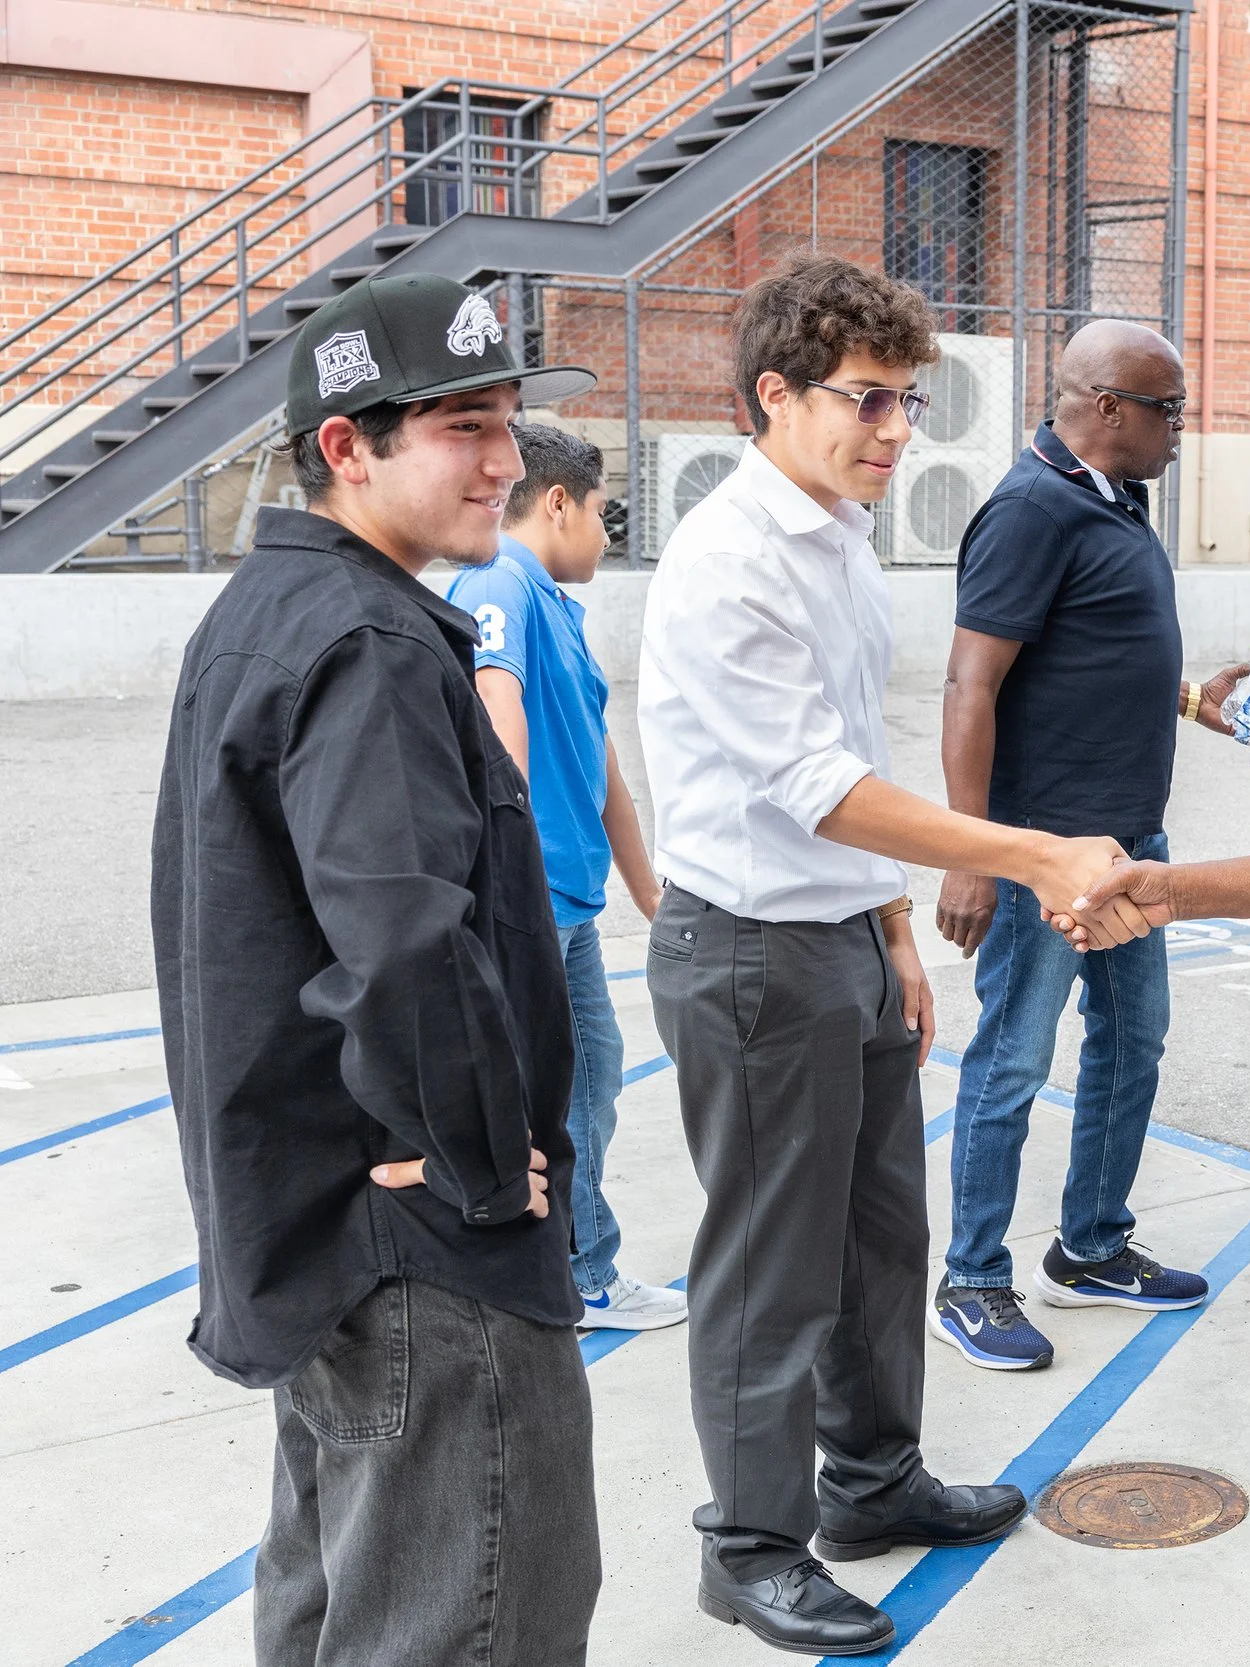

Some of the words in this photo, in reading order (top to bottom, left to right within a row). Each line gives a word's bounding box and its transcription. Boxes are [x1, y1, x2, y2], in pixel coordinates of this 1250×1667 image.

[340, 339, 361, 349] BOWL
[321, 345, 364, 375] LIX
[321, 365, 372, 388] CHAMPIONS
[474, 603, 506, 652] 3
